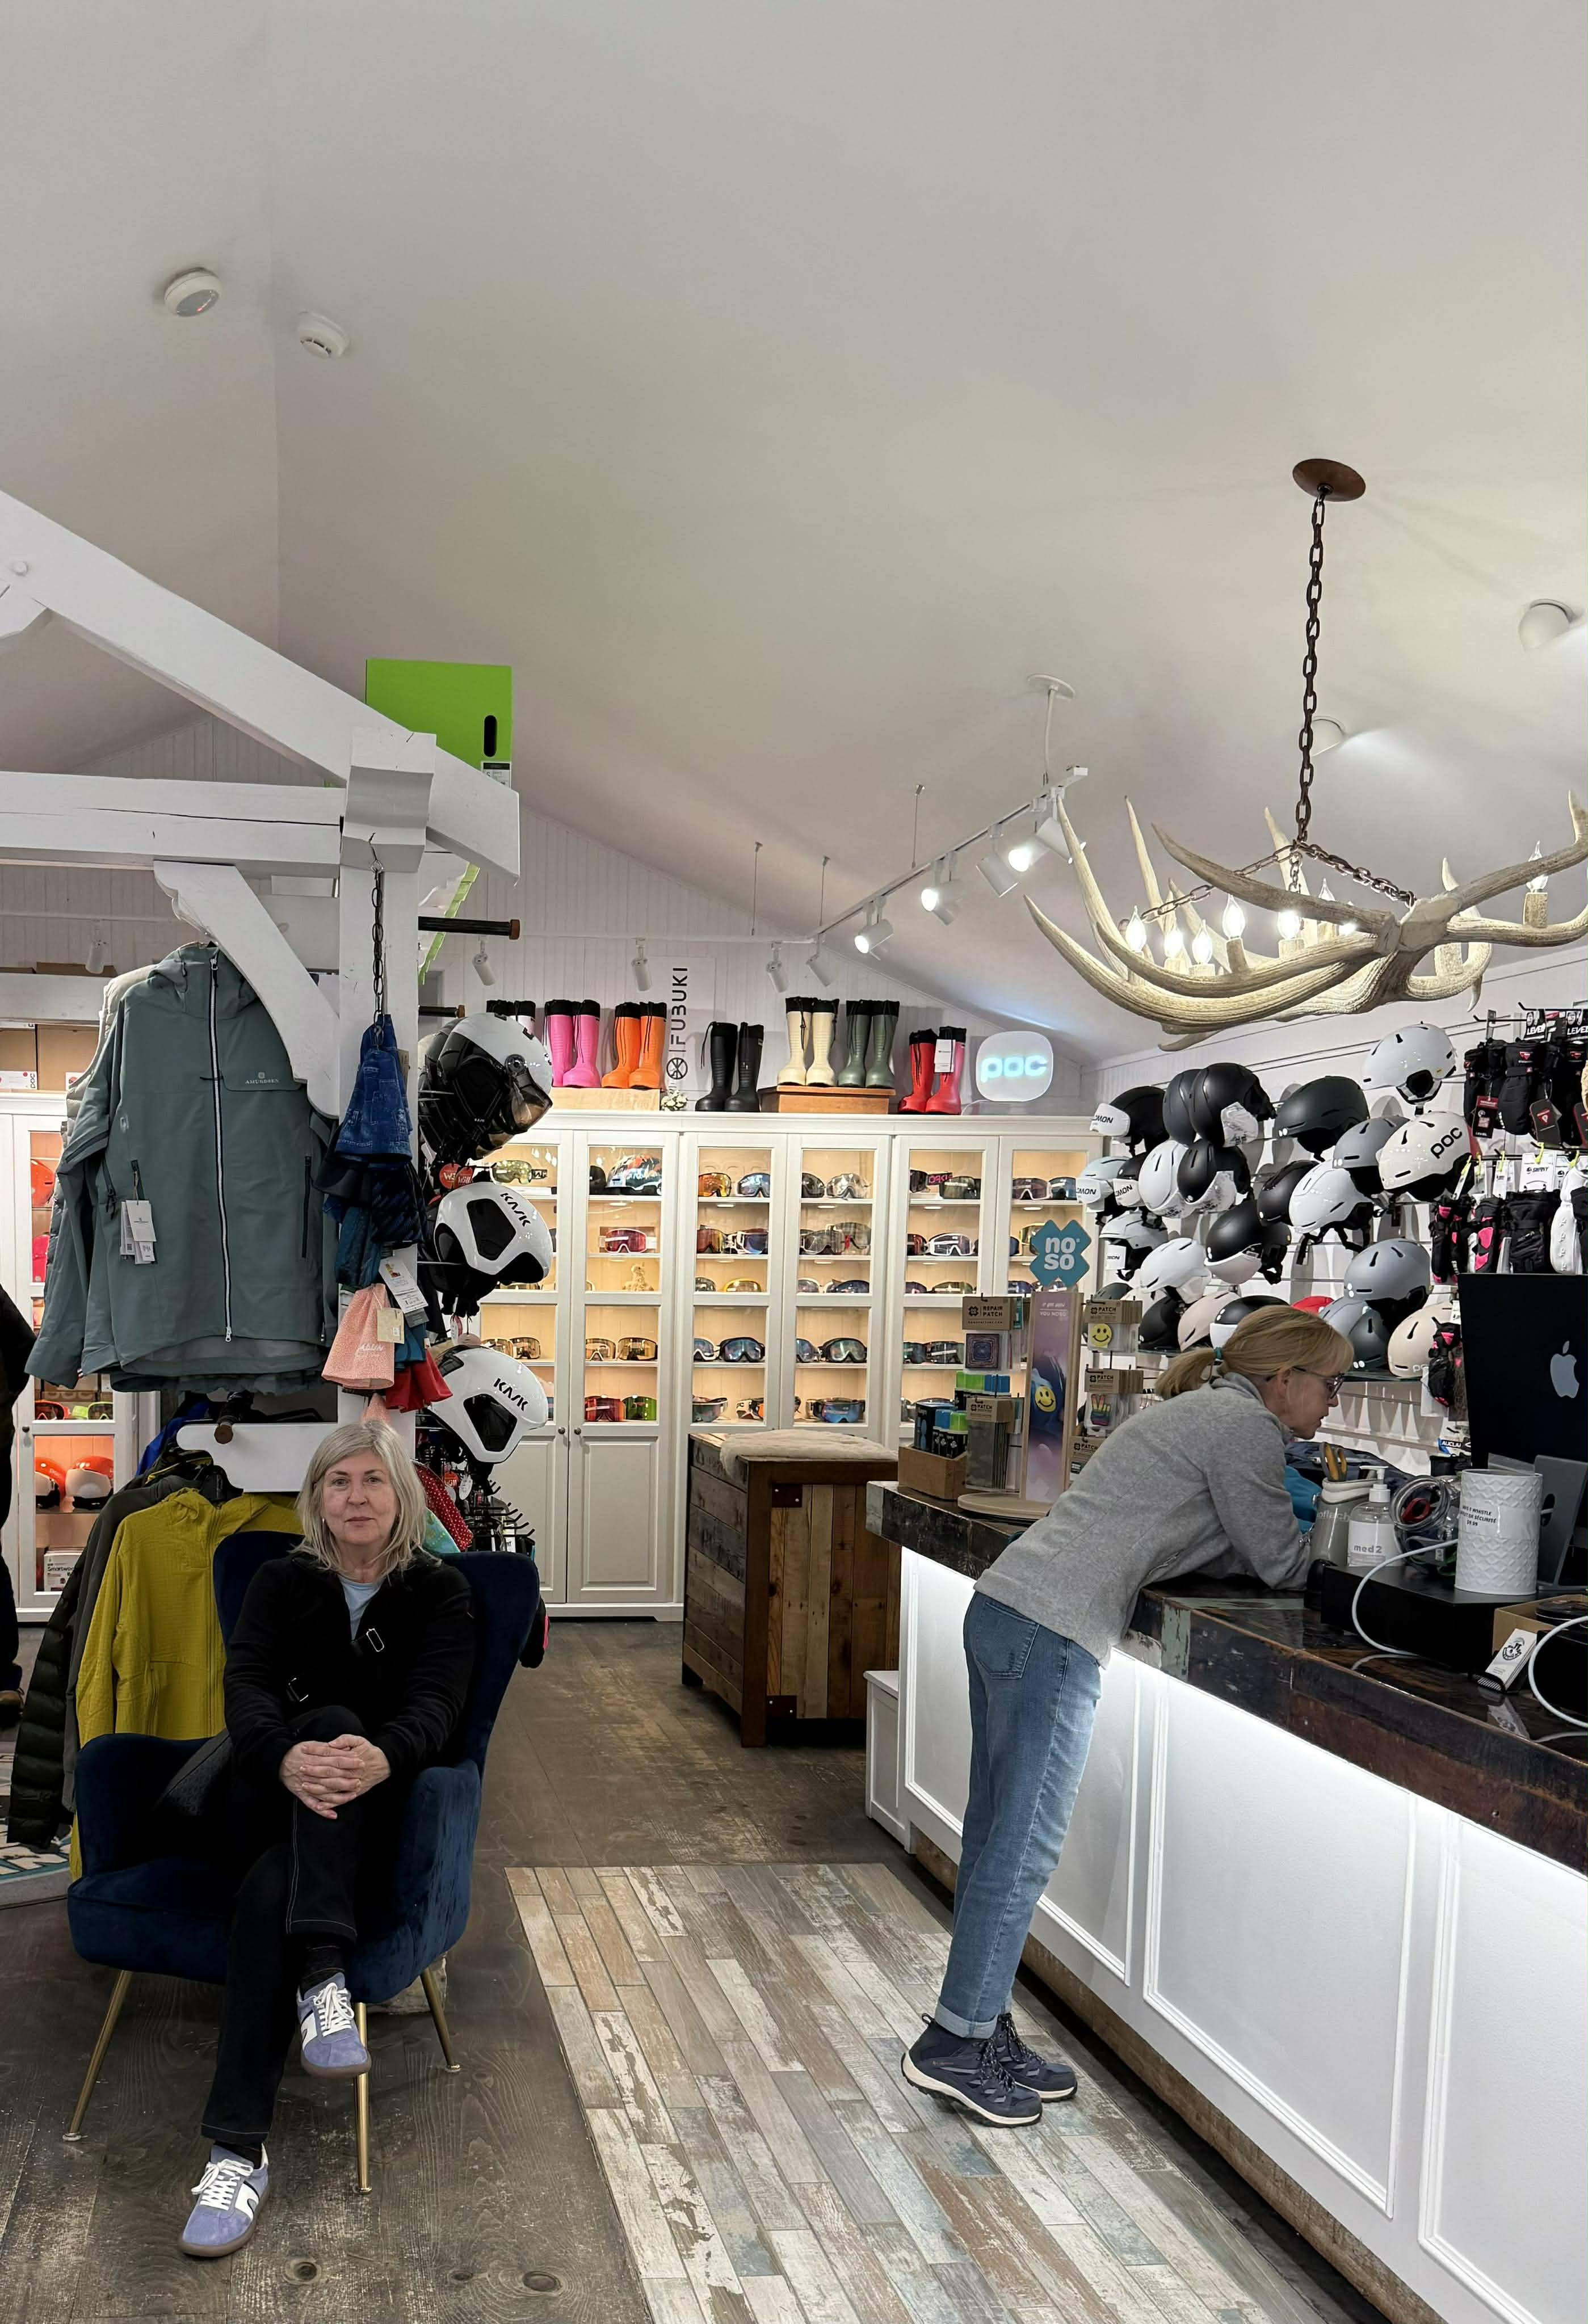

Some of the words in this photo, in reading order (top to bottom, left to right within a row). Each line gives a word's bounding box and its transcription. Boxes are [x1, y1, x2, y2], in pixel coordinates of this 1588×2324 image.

[670, 967, 688, 1045] FUBUKI
[500, 1193, 531, 1227] KASK
[493, 1378, 528, 1412] KASK
